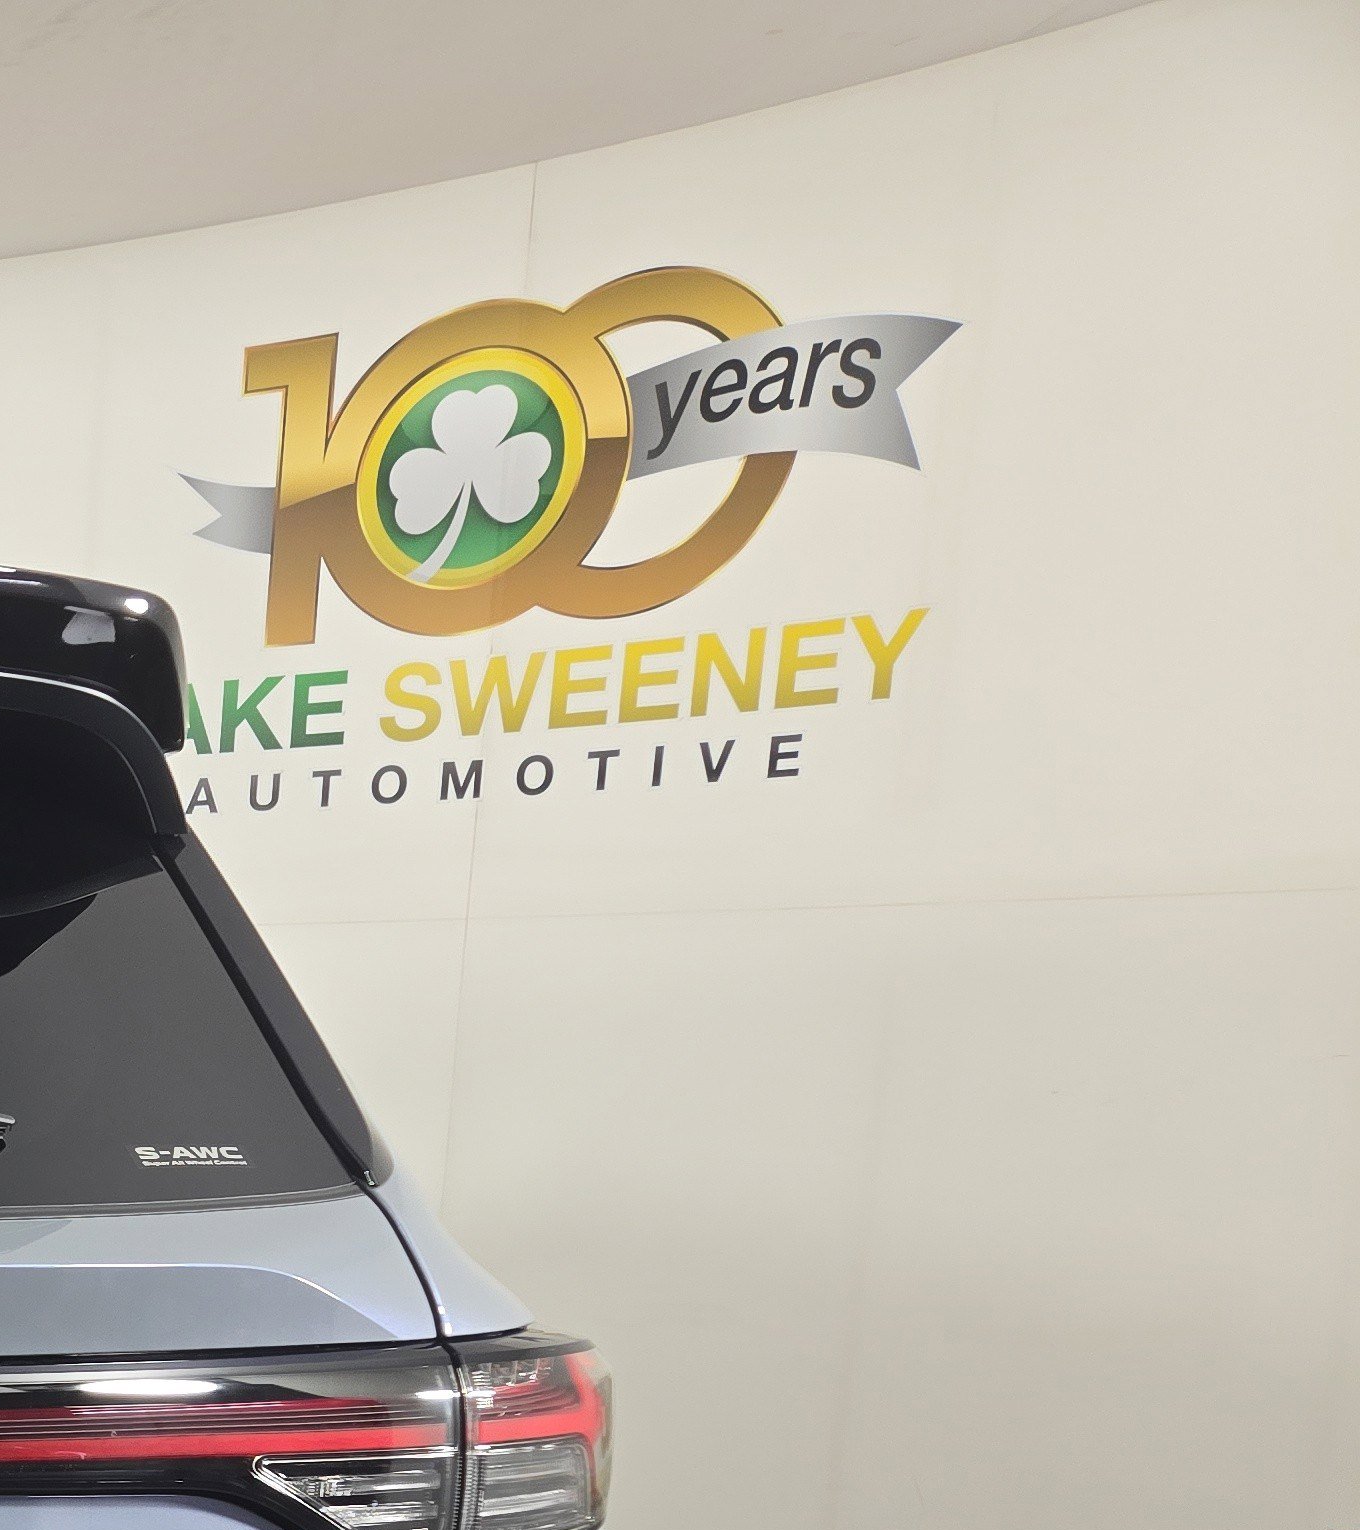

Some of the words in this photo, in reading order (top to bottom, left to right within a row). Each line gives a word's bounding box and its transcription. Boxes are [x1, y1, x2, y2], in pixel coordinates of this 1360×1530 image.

[242, 266, 799, 648] 100
[646, 335, 883, 462] years
[379, 608, 930, 743] SWEENEY
[186, 734, 803, 815] AUTOMOTIVE
[135, 1146, 244, 1160] S-AWC
